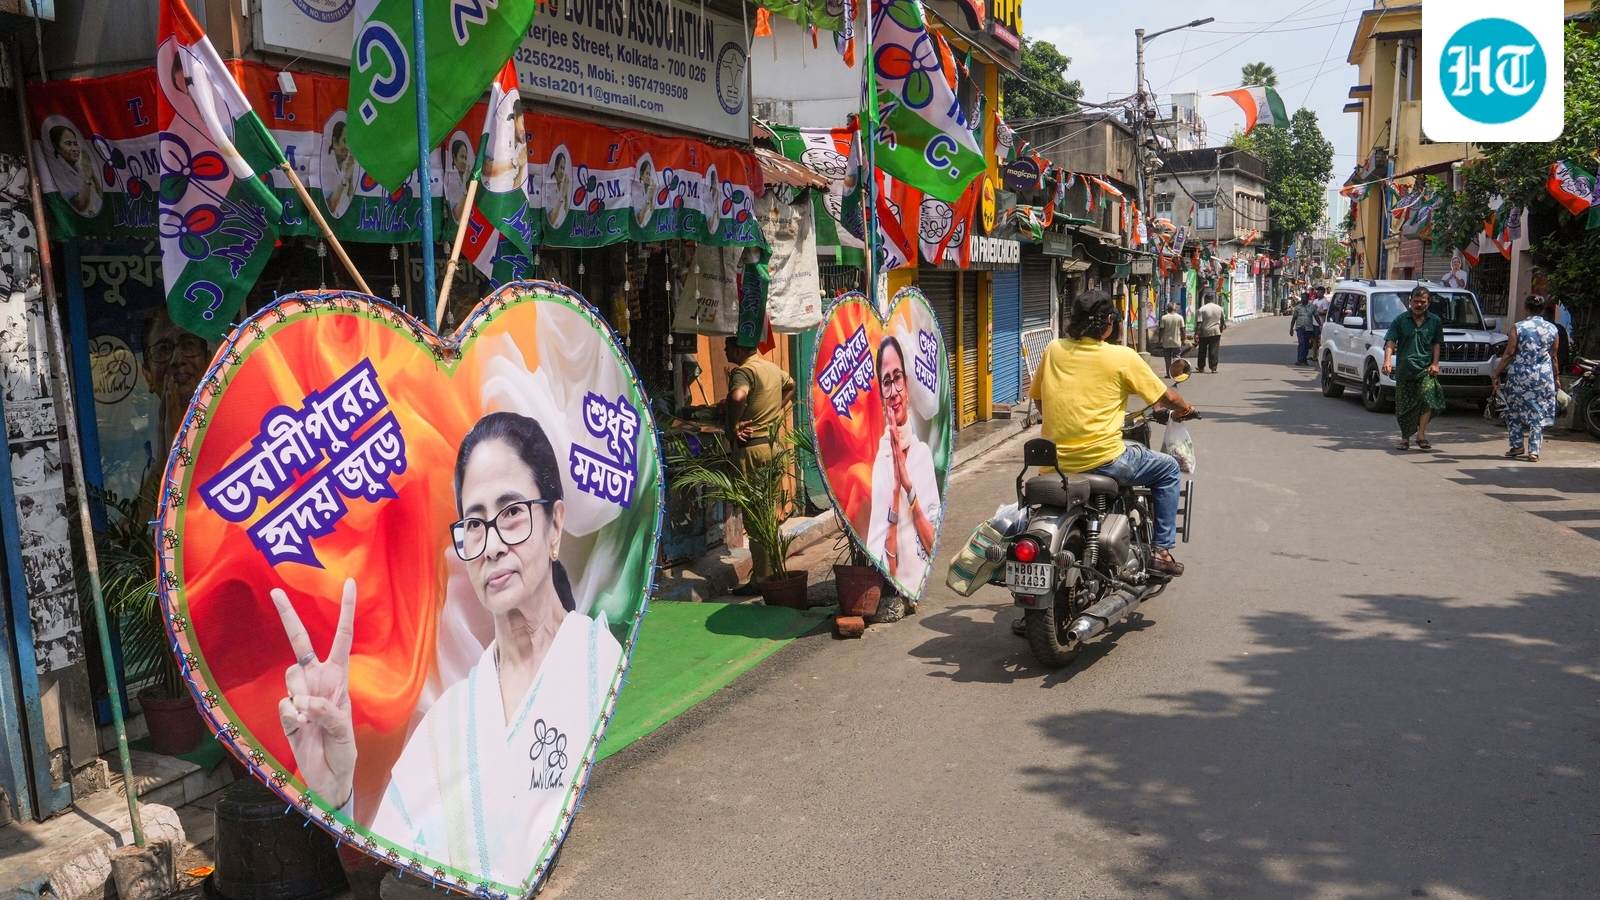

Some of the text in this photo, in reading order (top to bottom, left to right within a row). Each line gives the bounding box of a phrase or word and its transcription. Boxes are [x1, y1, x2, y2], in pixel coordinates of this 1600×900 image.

[628, 0, 714, 63] ASSOCIATION
[513, 46, 583, 79] 32562295,
[587, 63, 618, 84] Mobi.
[628, 73, 688, 101] 9674799508
[525, 24, 568, 48] terjee
[572, 31, 613, 63] Street,
[617, 43, 659, 72] Kolkata
[667, 57, 686, 78] 700
[688, 63, 706, 83] 026
[529, 71, 664, 113] ksla2011@gmail.com
[607, 143, 619, 164] T.
[924, 133, 958, 178] C.
[1007, 169, 1037, 179] magicpin
[607, 179, 625, 199] M.
[687, 180, 700, 200] M.
[606, 215, 621, 234] C.
[683, 214, 697, 233] C.
[819, 327, 867, 390] ভবানীপুরের
[919, 333, 937, 367] শুধুই
[915, 360, 936, 390] মমতা
[208, 367, 381, 514] ভবানীপুরের
[586, 398, 638, 456] শুধুই
[257, 421, 402, 556] হৃদয় জুড়ে
[574, 450, 634, 503] মমতা
[1014, 563, 1046, 577] WB01A
